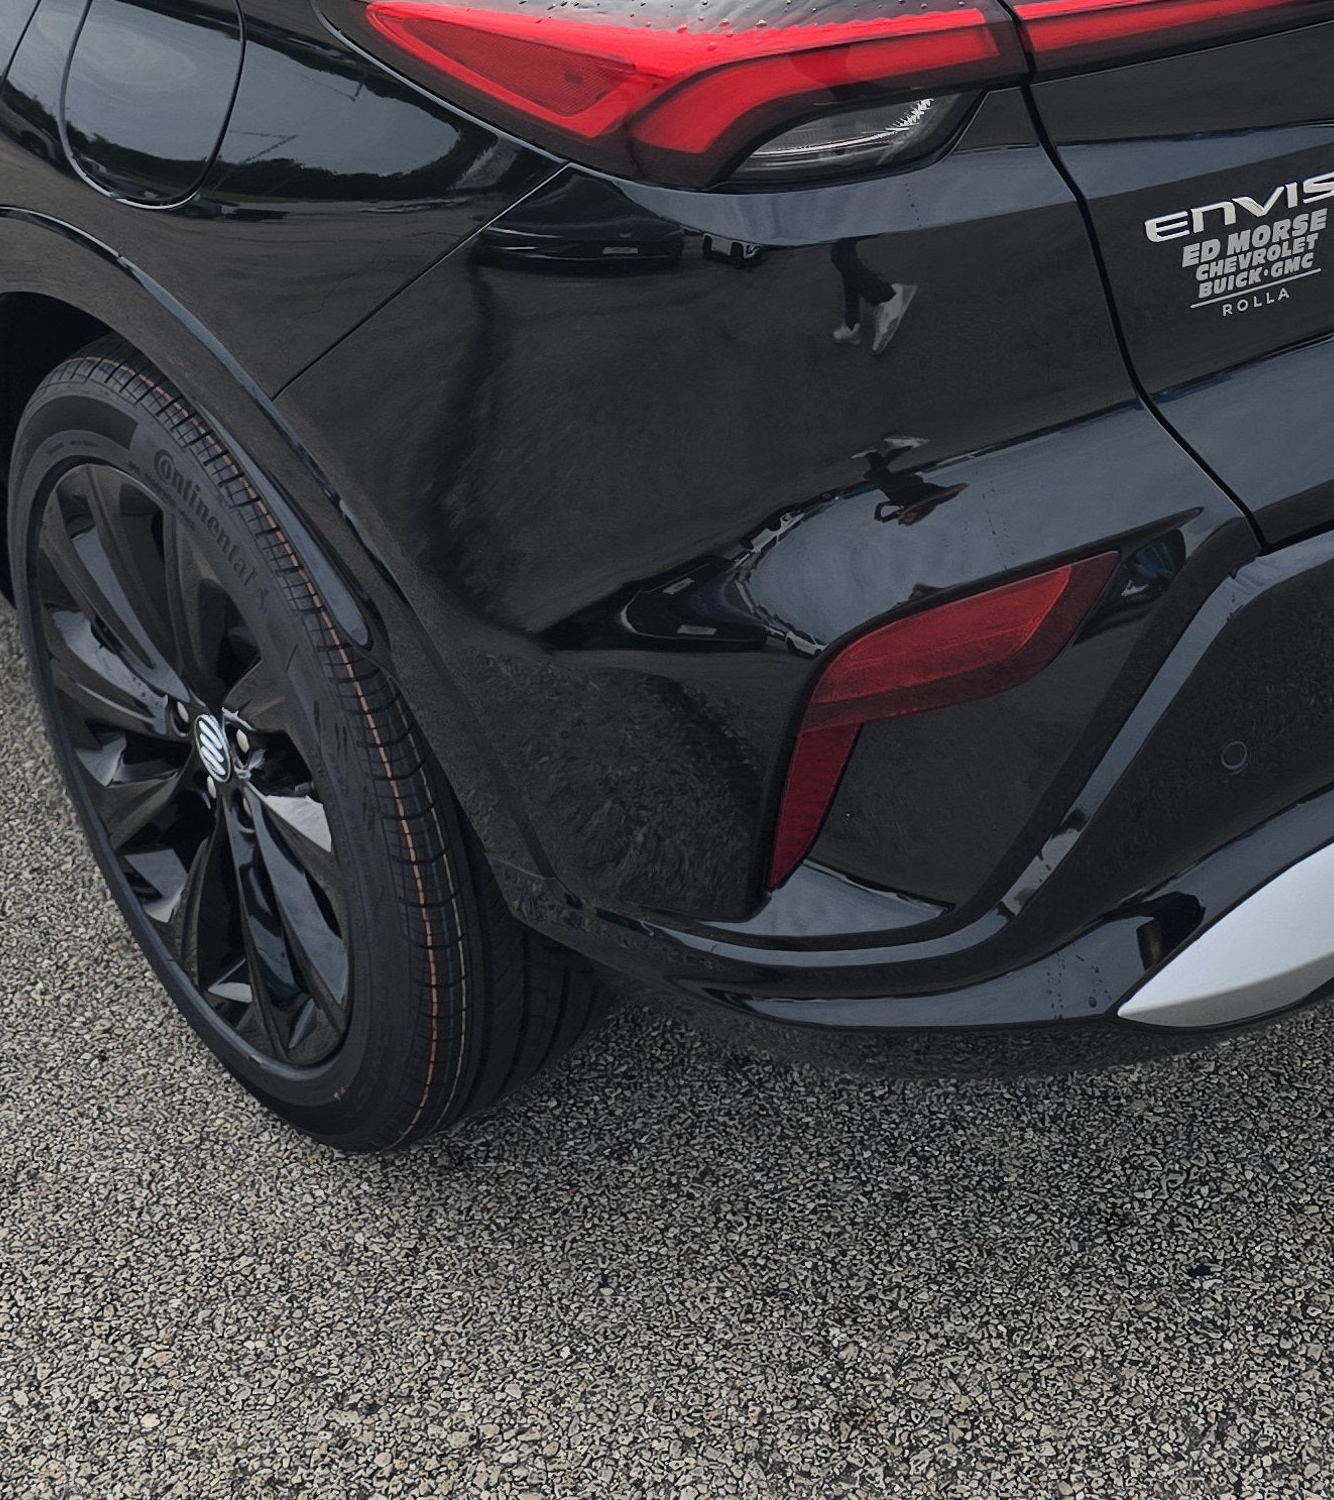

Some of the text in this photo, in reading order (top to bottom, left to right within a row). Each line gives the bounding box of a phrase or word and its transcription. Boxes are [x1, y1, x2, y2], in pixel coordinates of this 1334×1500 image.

[1181, 207, 1328, 268] ED MORSE
[1195, 233, 1319, 282] CHEVROLET
[1223, 287, 1290, 317] ROLLA
[154, 449, 258, 586] Continental
